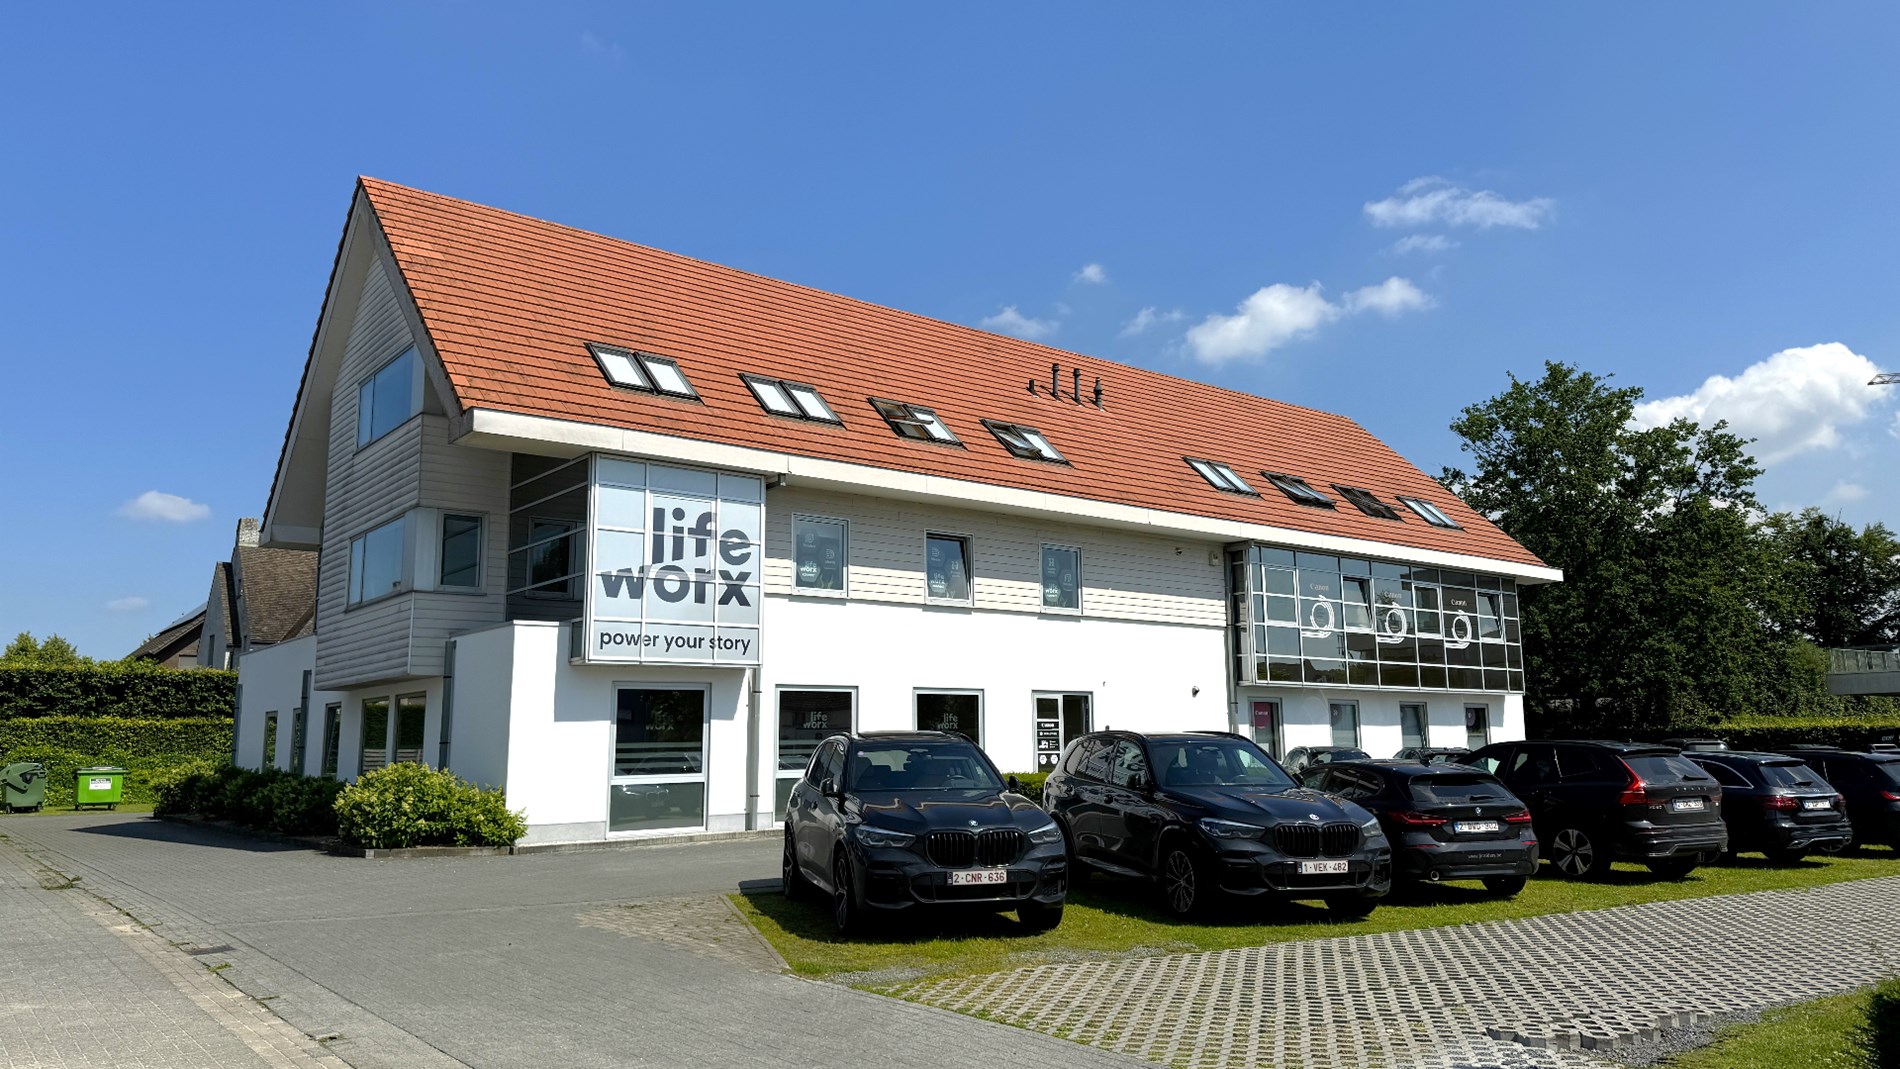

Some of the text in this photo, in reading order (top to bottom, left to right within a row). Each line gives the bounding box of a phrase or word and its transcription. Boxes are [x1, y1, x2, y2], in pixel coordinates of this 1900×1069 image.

[652, 507, 752, 566] life
[600, 565, 752, 607] worx
[1310, 583, 1329, 591] Canon
[600, 632, 751, 655] power your story
[811, 711, 828, 722] life
[944, 713, 958, 723] life
[803, 720, 828, 729] worx
[937, 722, 959, 730] worx
[954, 872, 1005, 883] 2-CNR-636
